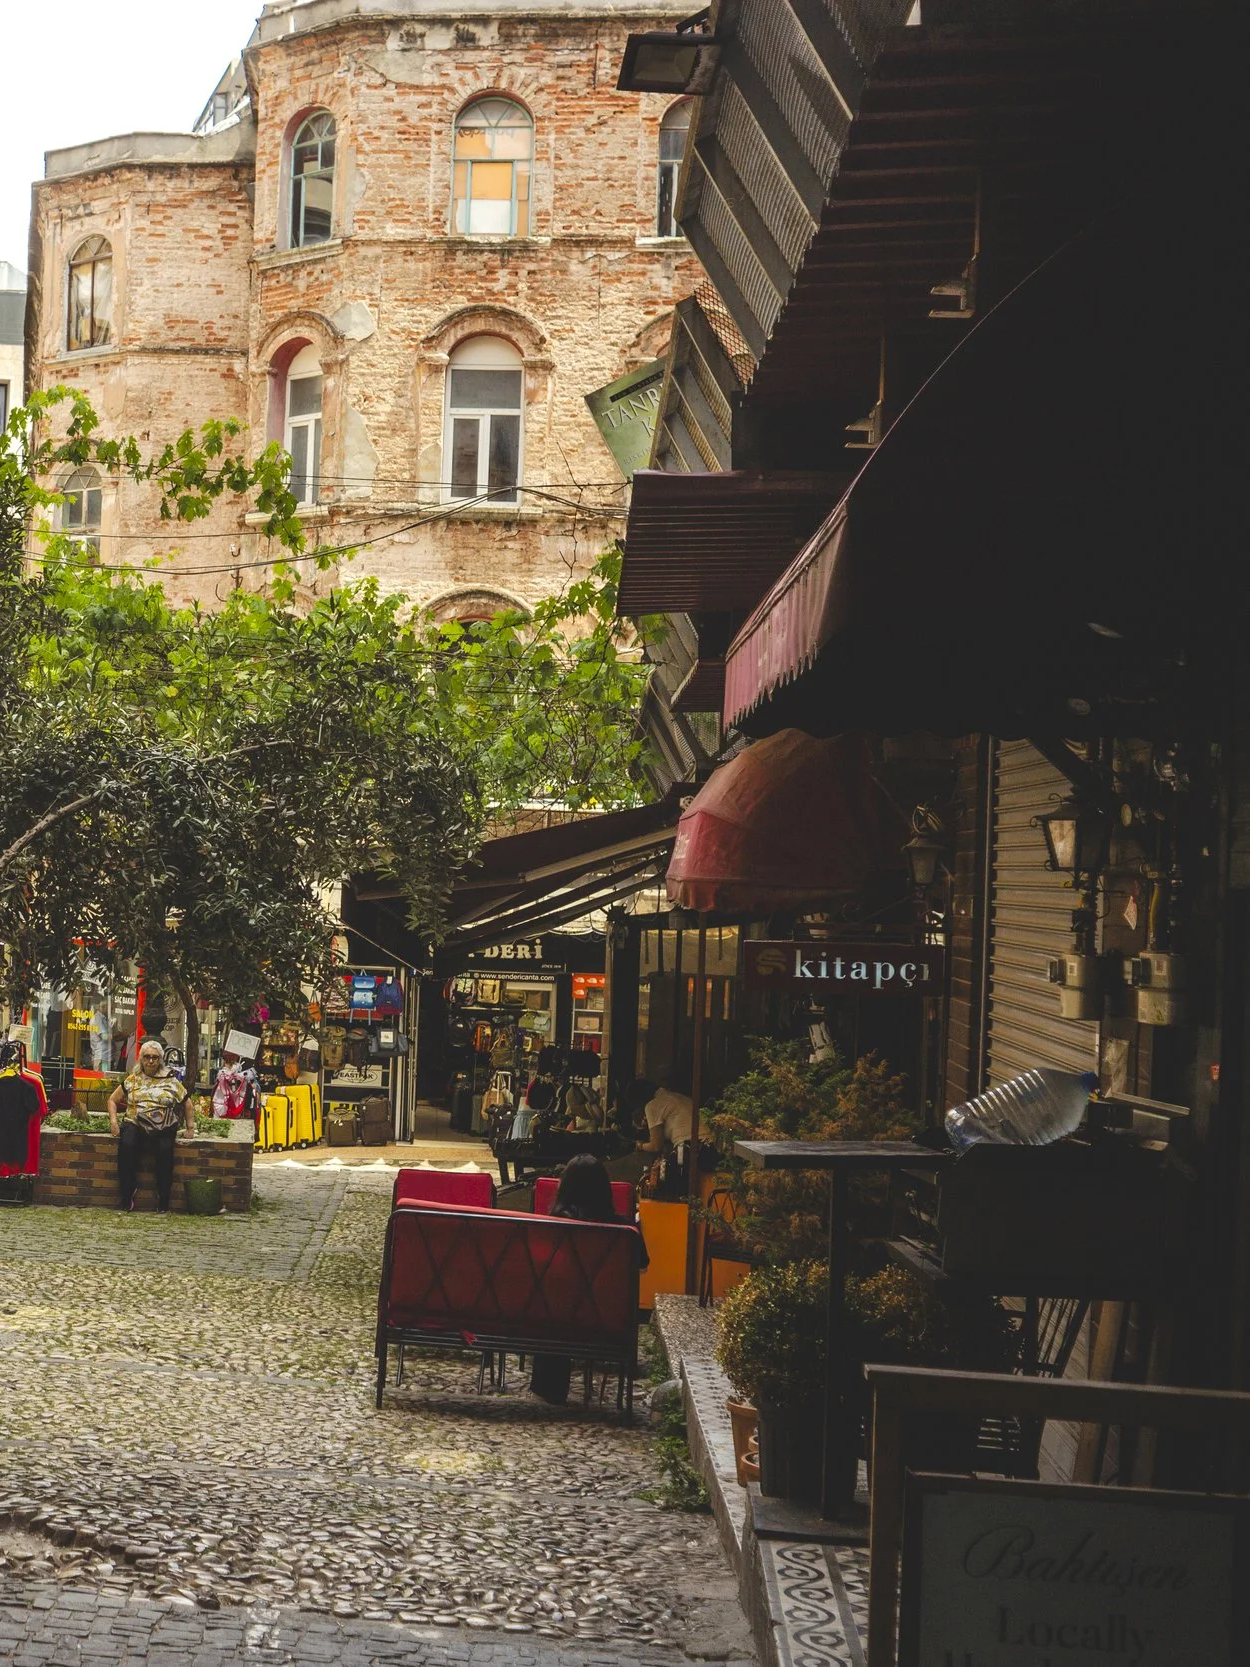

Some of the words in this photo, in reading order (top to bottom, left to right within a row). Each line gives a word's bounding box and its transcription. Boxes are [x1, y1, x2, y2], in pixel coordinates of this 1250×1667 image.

[601, 383, 663, 429] TANR
[480, 973, 555, 982] www.sendericanta.com
[793, 949, 931, 989] kitapçı
[71, 1009, 94, 1019] SALON
[997, 1605, 1155, 1659] Locally
